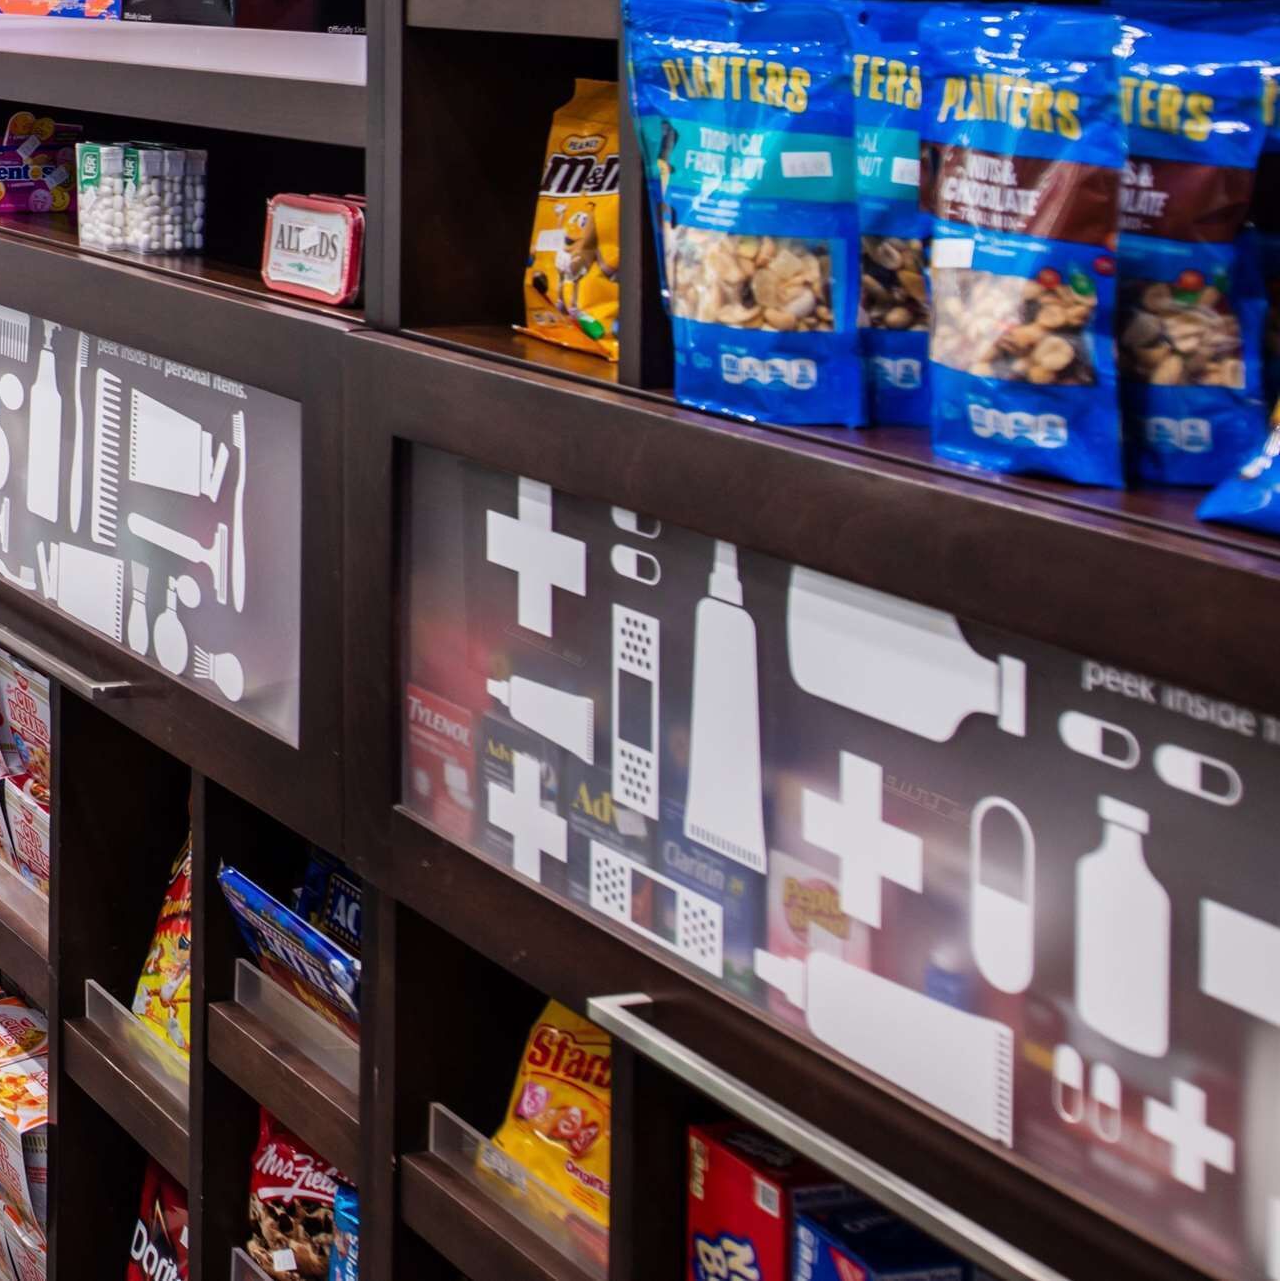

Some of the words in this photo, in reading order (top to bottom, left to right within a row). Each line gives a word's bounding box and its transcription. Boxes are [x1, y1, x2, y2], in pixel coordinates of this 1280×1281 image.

[661, 54, 812, 114] PLANTERS
[937, 72, 1084, 142] PLANTERS
[942, 175, 1042, 217] CHOCOLATE
[274, 223, 339, 261] ALTDS
[97, 339, 120, 356] peek
[121, 346, 147, 366] inside
[164, 360, 210, 387] personal
[212, 374, 248, 400] items.
[407, 694, 471, 748] TYLENOL
[1080, 659, 1157, 705] peek
[1162, 684, 1257, 739] inside
